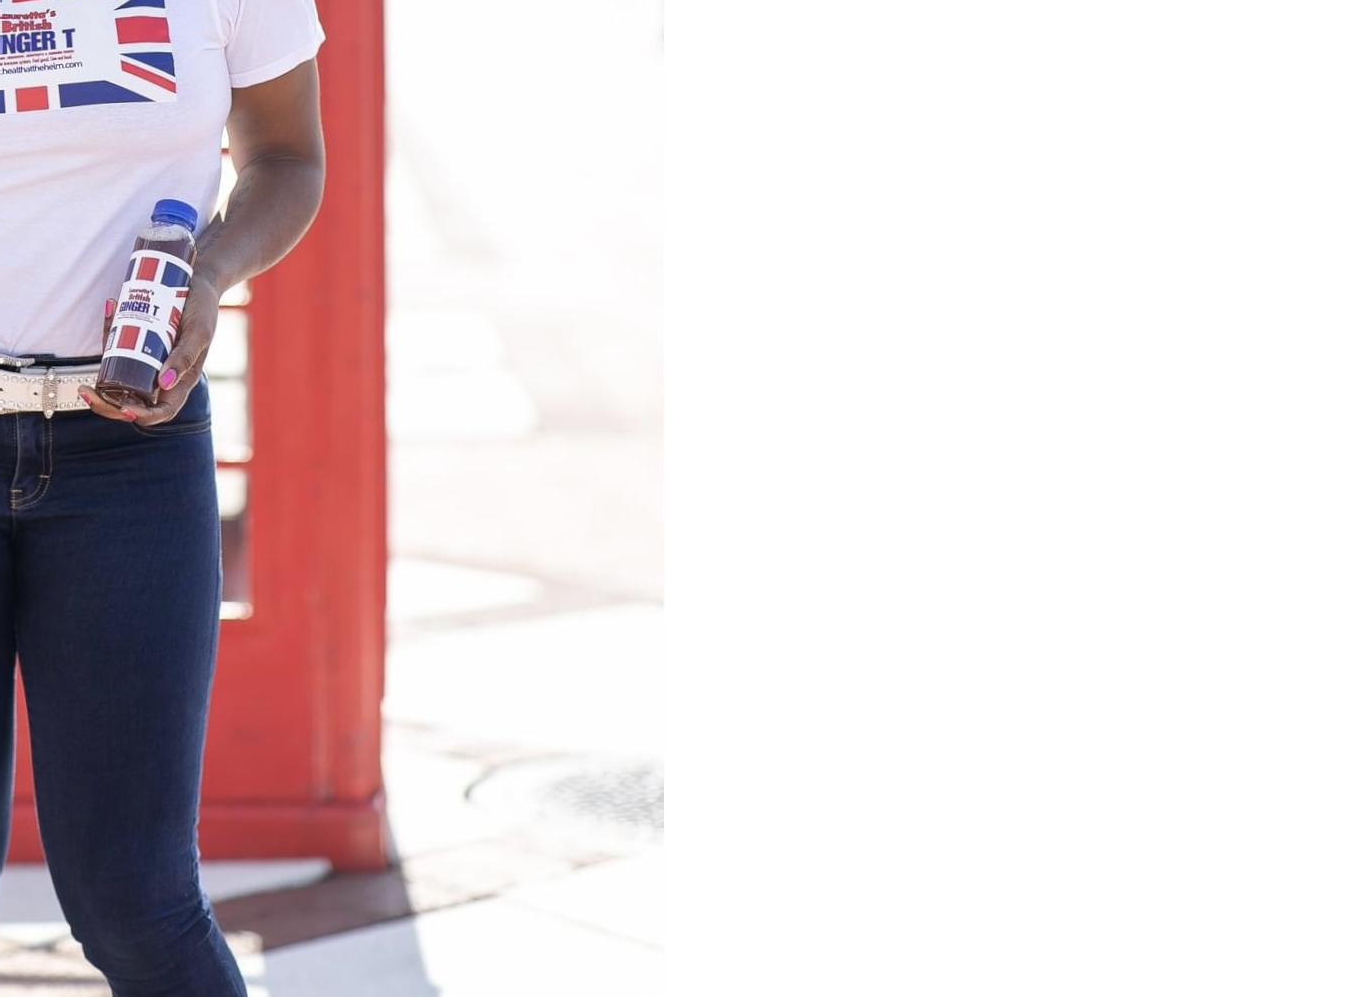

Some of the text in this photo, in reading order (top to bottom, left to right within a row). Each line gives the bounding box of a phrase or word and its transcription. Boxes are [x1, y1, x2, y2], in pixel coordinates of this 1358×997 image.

[2, 19, 52, 33] British
[62, 28, 75, 48] T
[119, 301, 160, 316] GINGER T
